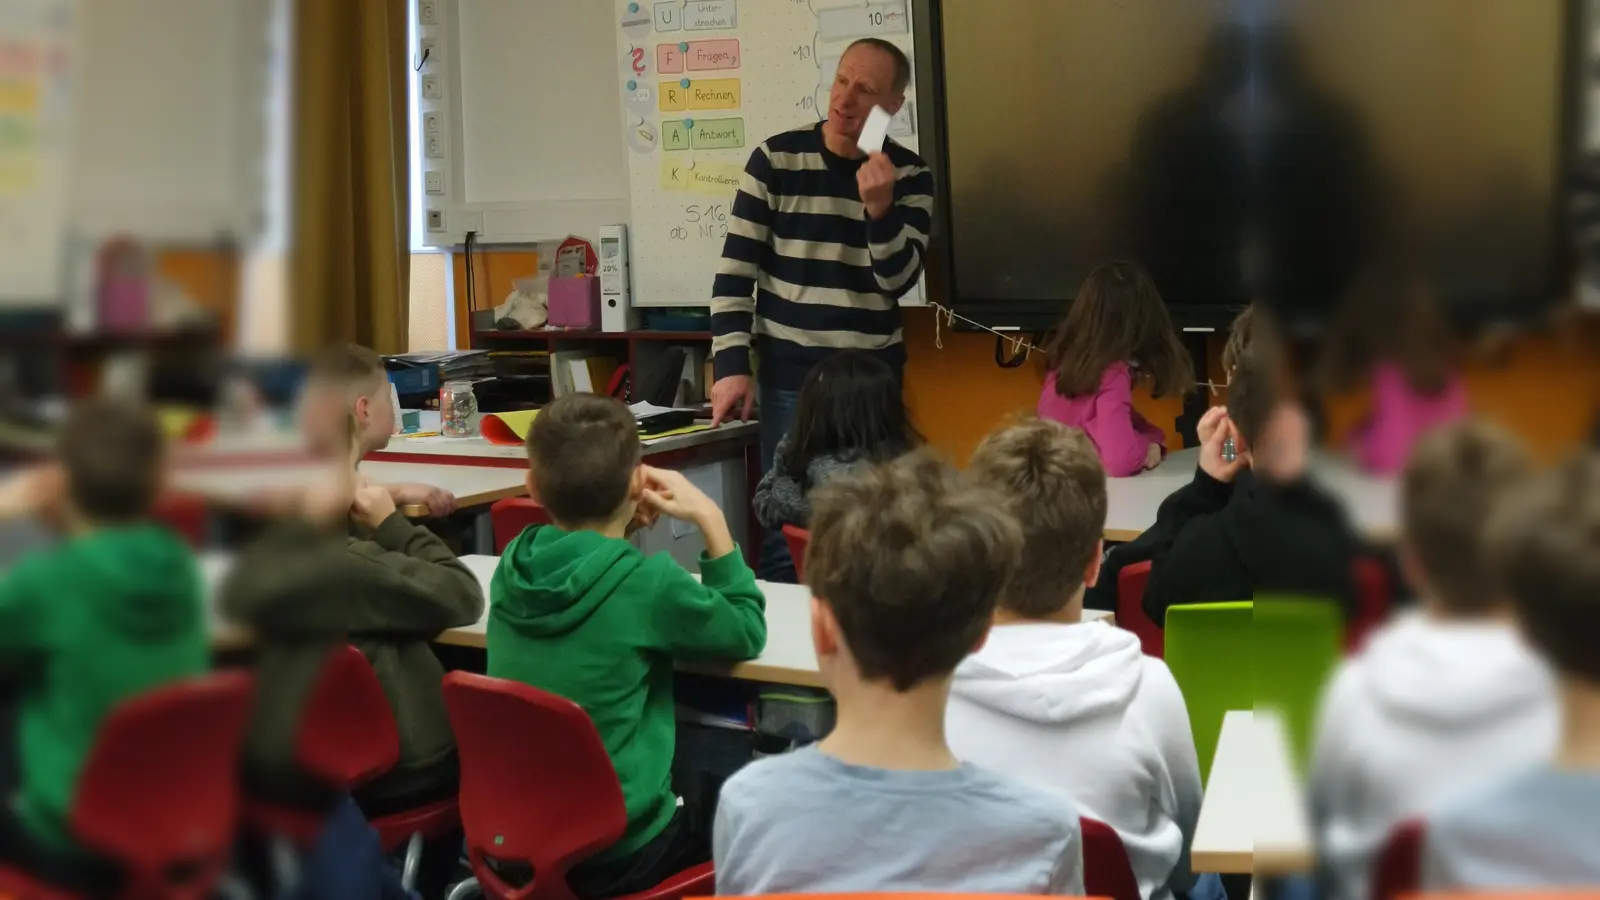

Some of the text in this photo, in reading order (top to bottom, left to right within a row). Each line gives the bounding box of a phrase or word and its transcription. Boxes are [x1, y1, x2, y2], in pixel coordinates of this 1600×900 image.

[662, 10, 672, 24] U
[868, 12, 883, 26] 10
[664, 51, 674, 66] F
[668, 89, 677, 104] R
[695, 88, 734, 101] Rechnen
[672, 130, 680, 143] A
[699, 128, 737, 140] Antwort
[671, 167, 679, 182] K
[694, 172, 740, 186] Kontrollieren
[670, 225, 688, 240] ab
[602, 265, 618, 273] 20%
